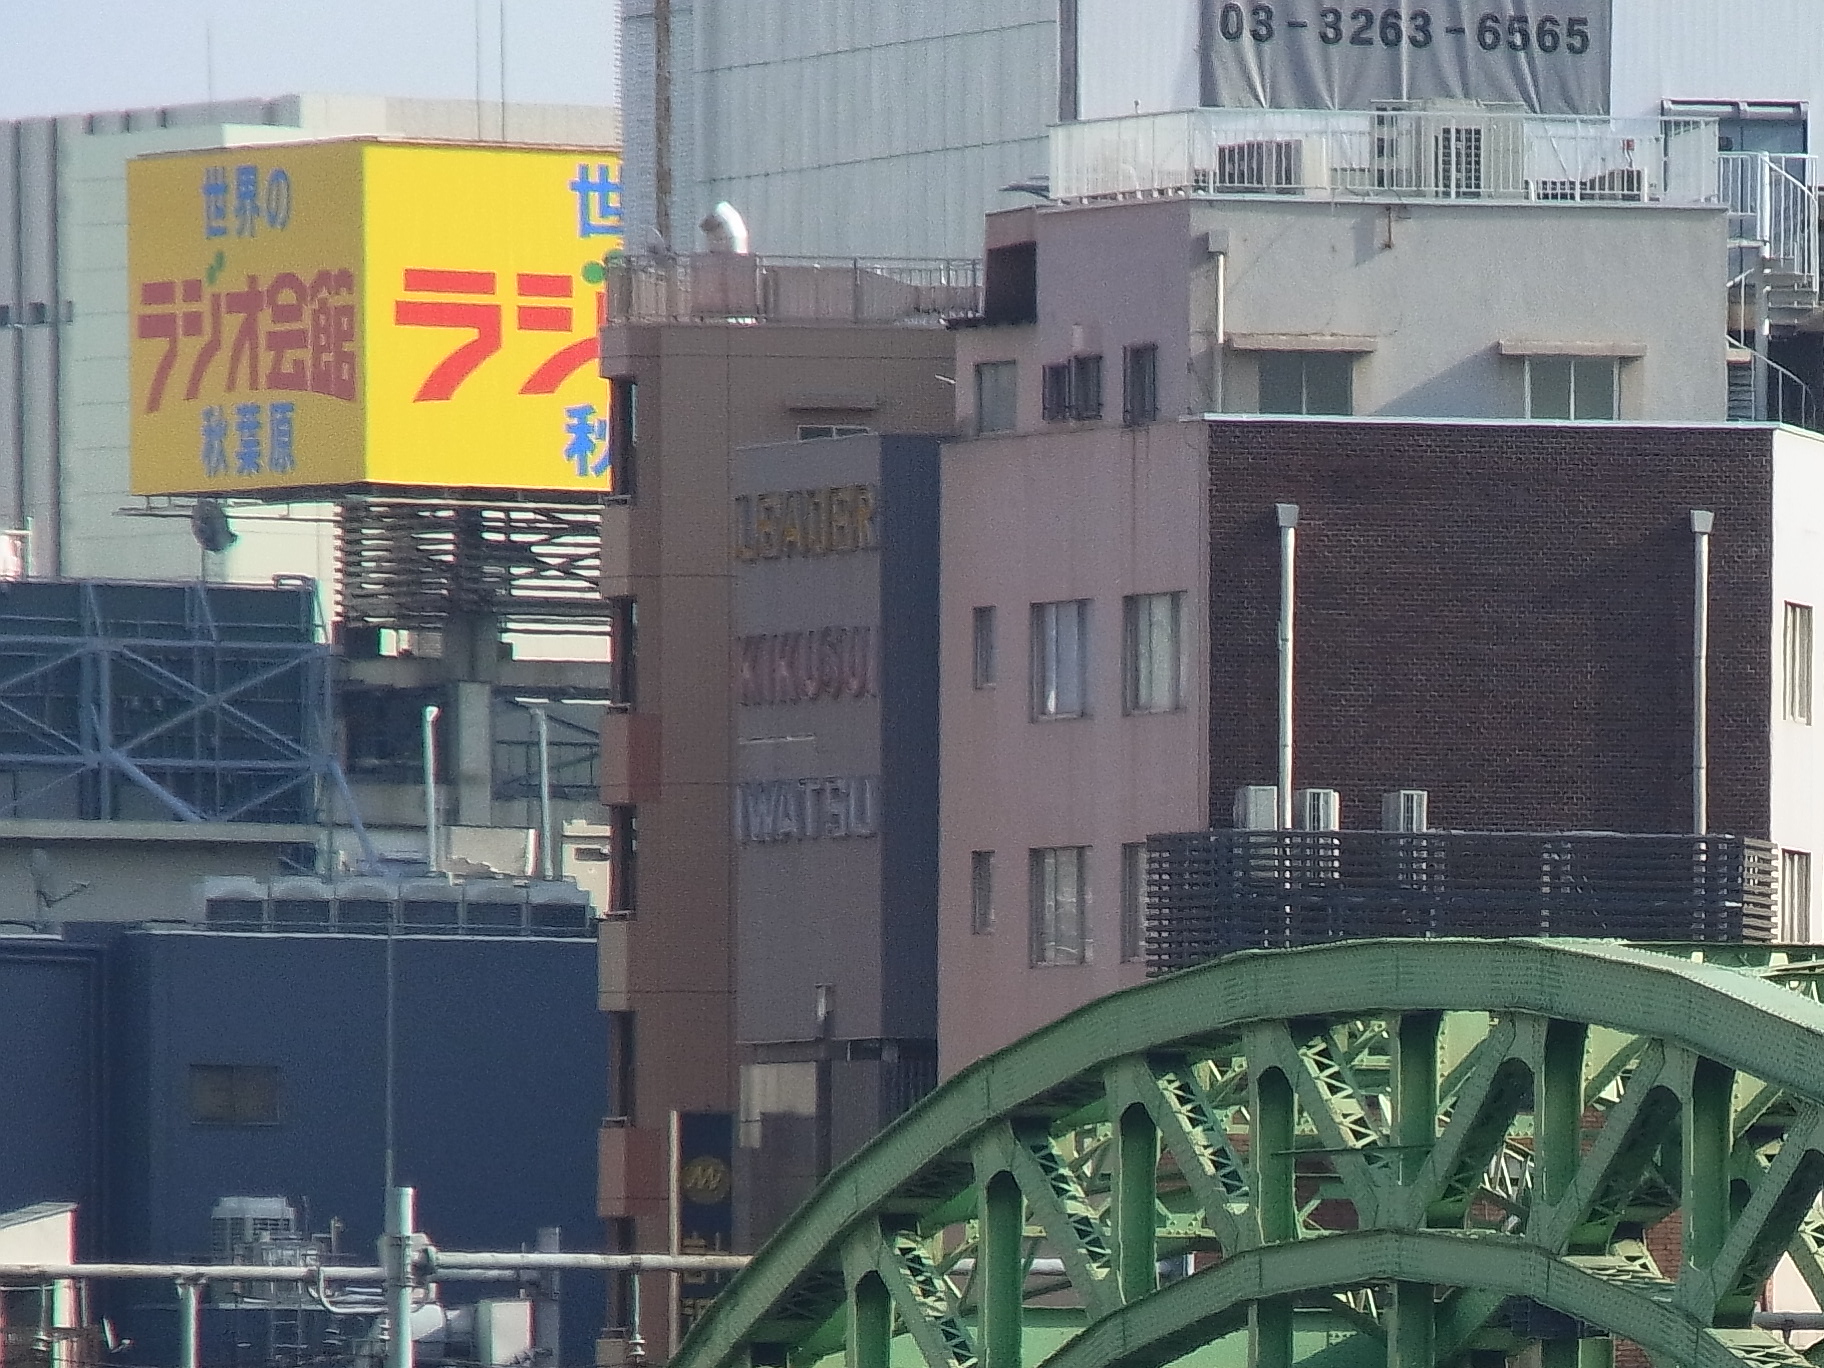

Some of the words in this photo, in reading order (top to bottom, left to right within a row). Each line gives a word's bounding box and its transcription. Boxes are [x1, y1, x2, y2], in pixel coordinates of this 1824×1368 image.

[201, 164, 293, 239] 世界の
[137, 251, 357, 414] ラジオ会館
[201, 402, 295, 478] 秋葉原
